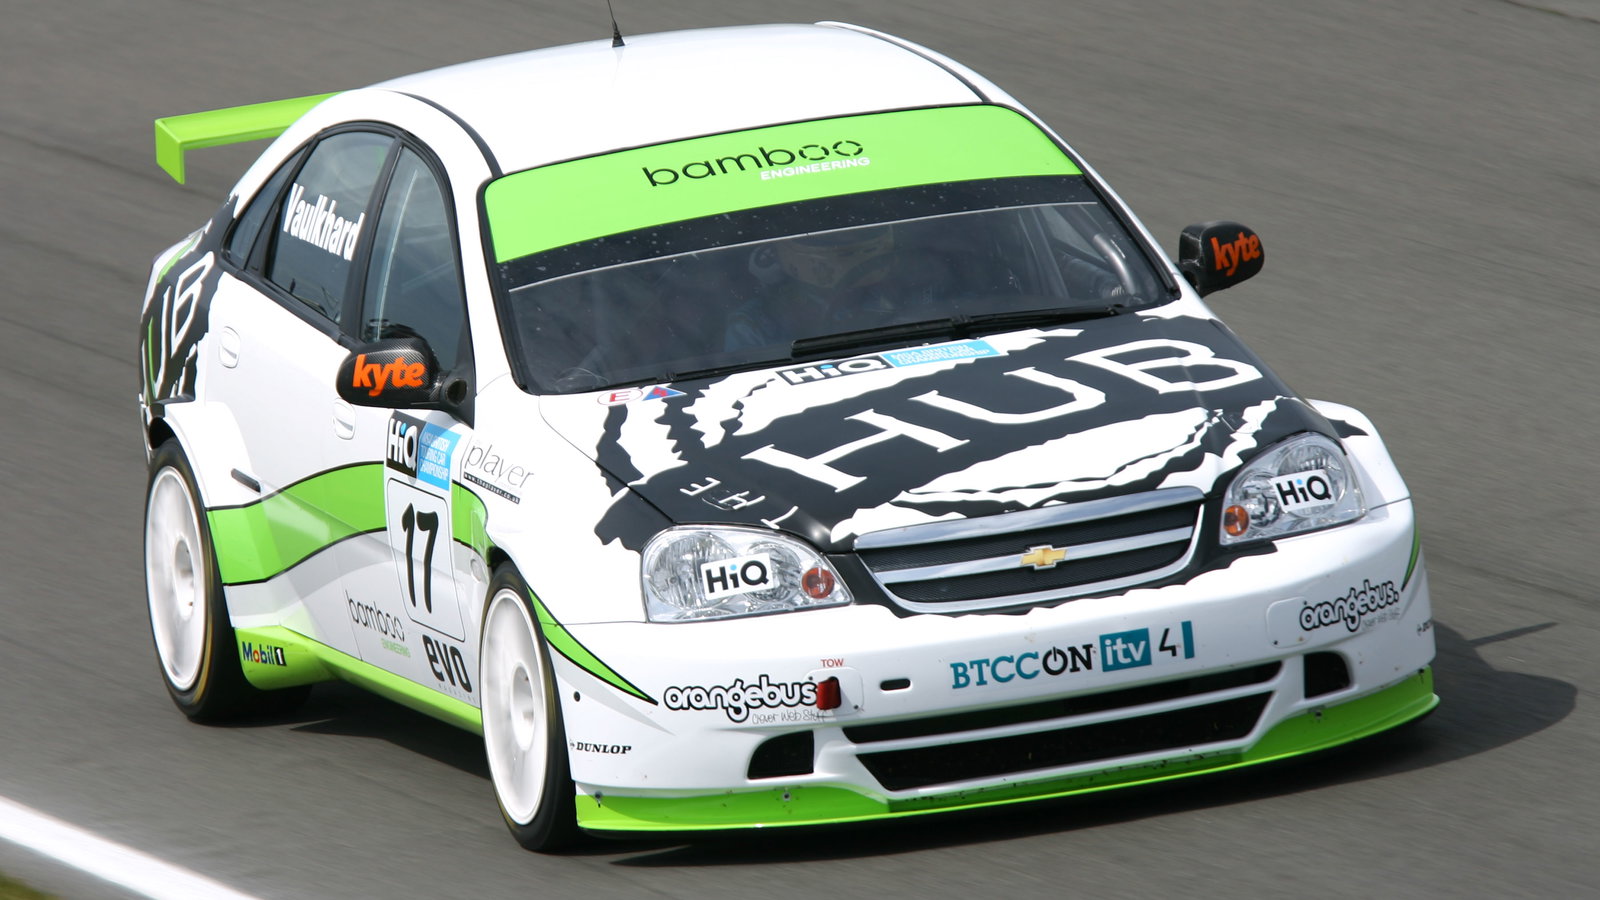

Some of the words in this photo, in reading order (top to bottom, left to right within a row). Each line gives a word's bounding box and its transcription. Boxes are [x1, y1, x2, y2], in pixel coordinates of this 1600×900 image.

[642, 141, 863, 186] bamboo
[759, 157, 870, 180] ENGINEERING
[283, 183, 365, 261] Vaulkhard
[1210, 231, 1260, 276] kyte
[353, 354, 426, 397] kyte
[783, 358, 887, 384] HiQ
[741, 338, 1263, 493] HUB
[387, 418, 418, 472] HiQ
[465, 444, 534, 488] player
[1275, 475, 1332, 505] HiQ
[401, 503, 439, 614] 17
[705, 560, 769, 594] HiQ
[345, 589, 405, 642] bamboo
[422, 634, 472, 693] evo
[820, 658, 844, 667] TOW
[576, 742, 632, 754] DUNLOP
